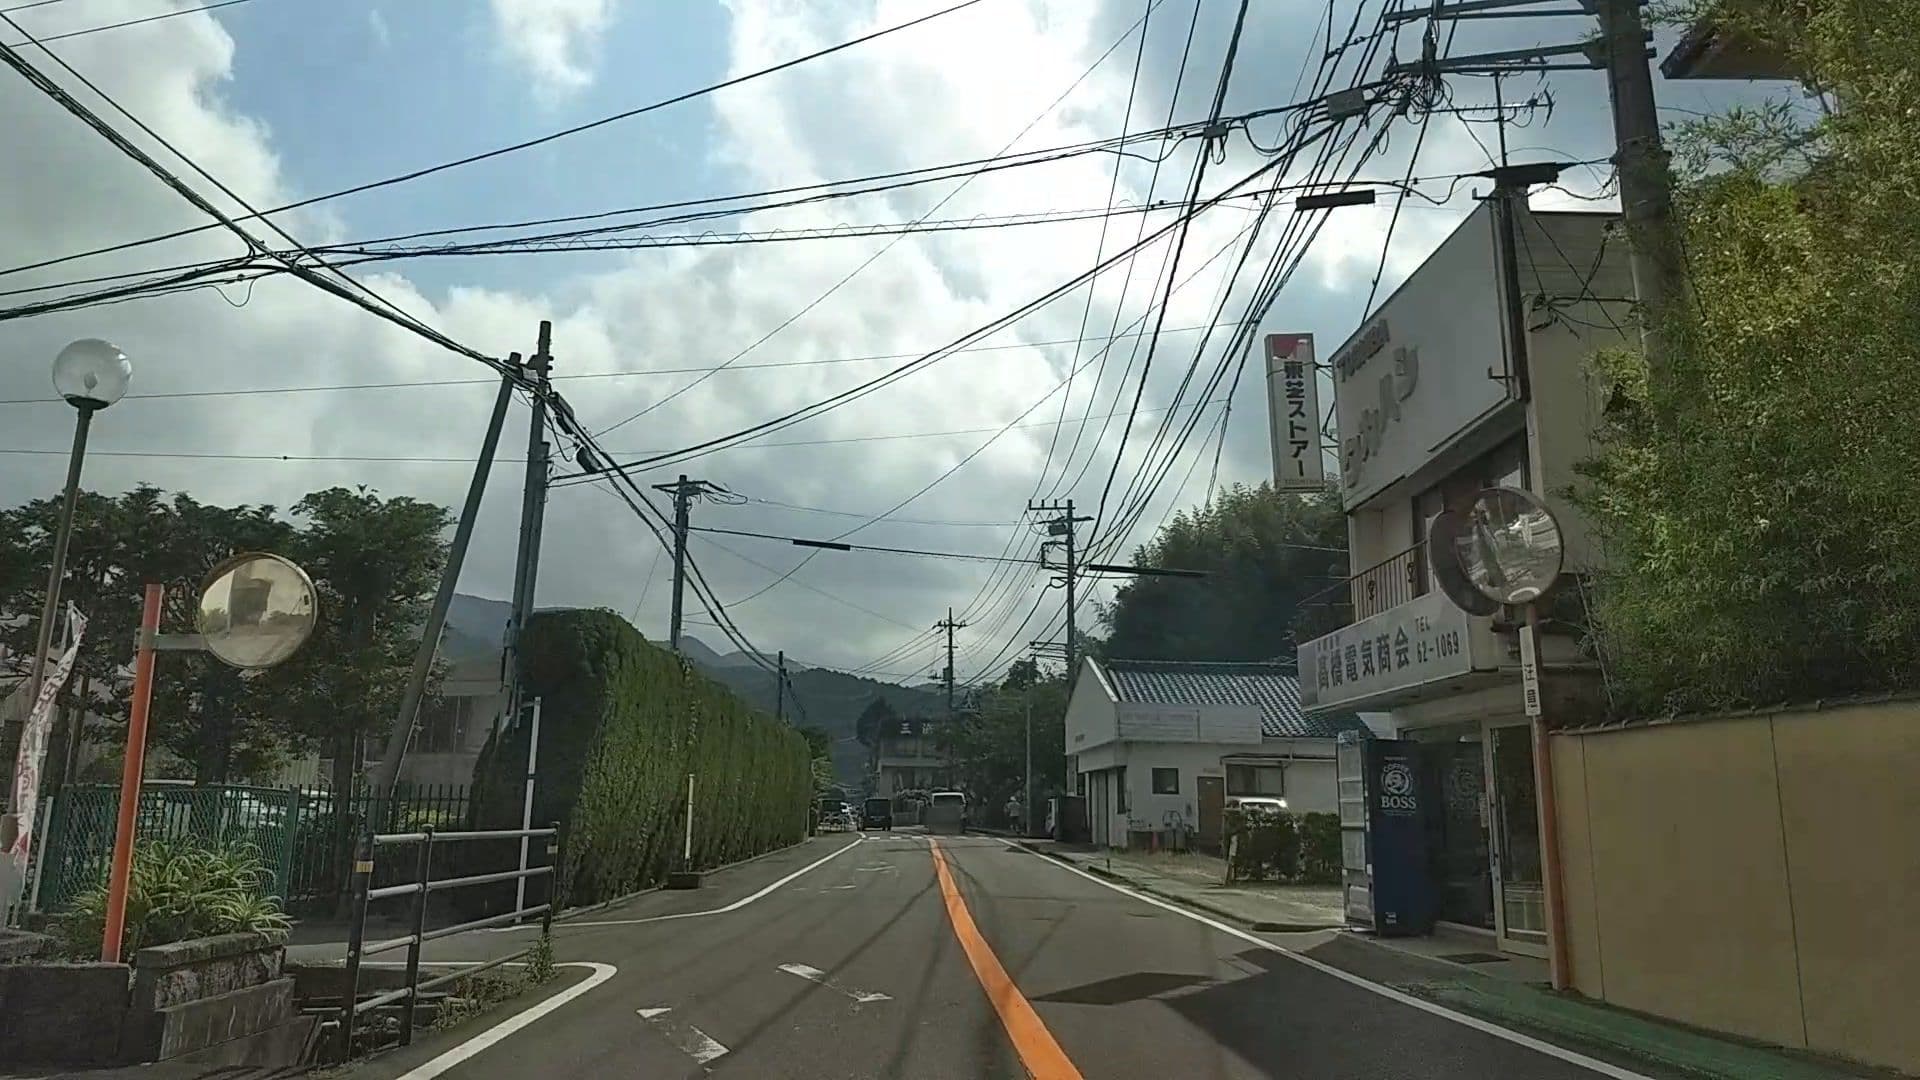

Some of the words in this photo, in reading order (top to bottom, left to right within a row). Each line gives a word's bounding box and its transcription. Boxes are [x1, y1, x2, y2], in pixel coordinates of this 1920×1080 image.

[1284, 361, 1309, 477] 東芝ストアー
[1415, 615, 1431, 632] TEL
[1416, 631, 1460, 664] 62-1069
[1381, 795, 1417, 810] BOSS
